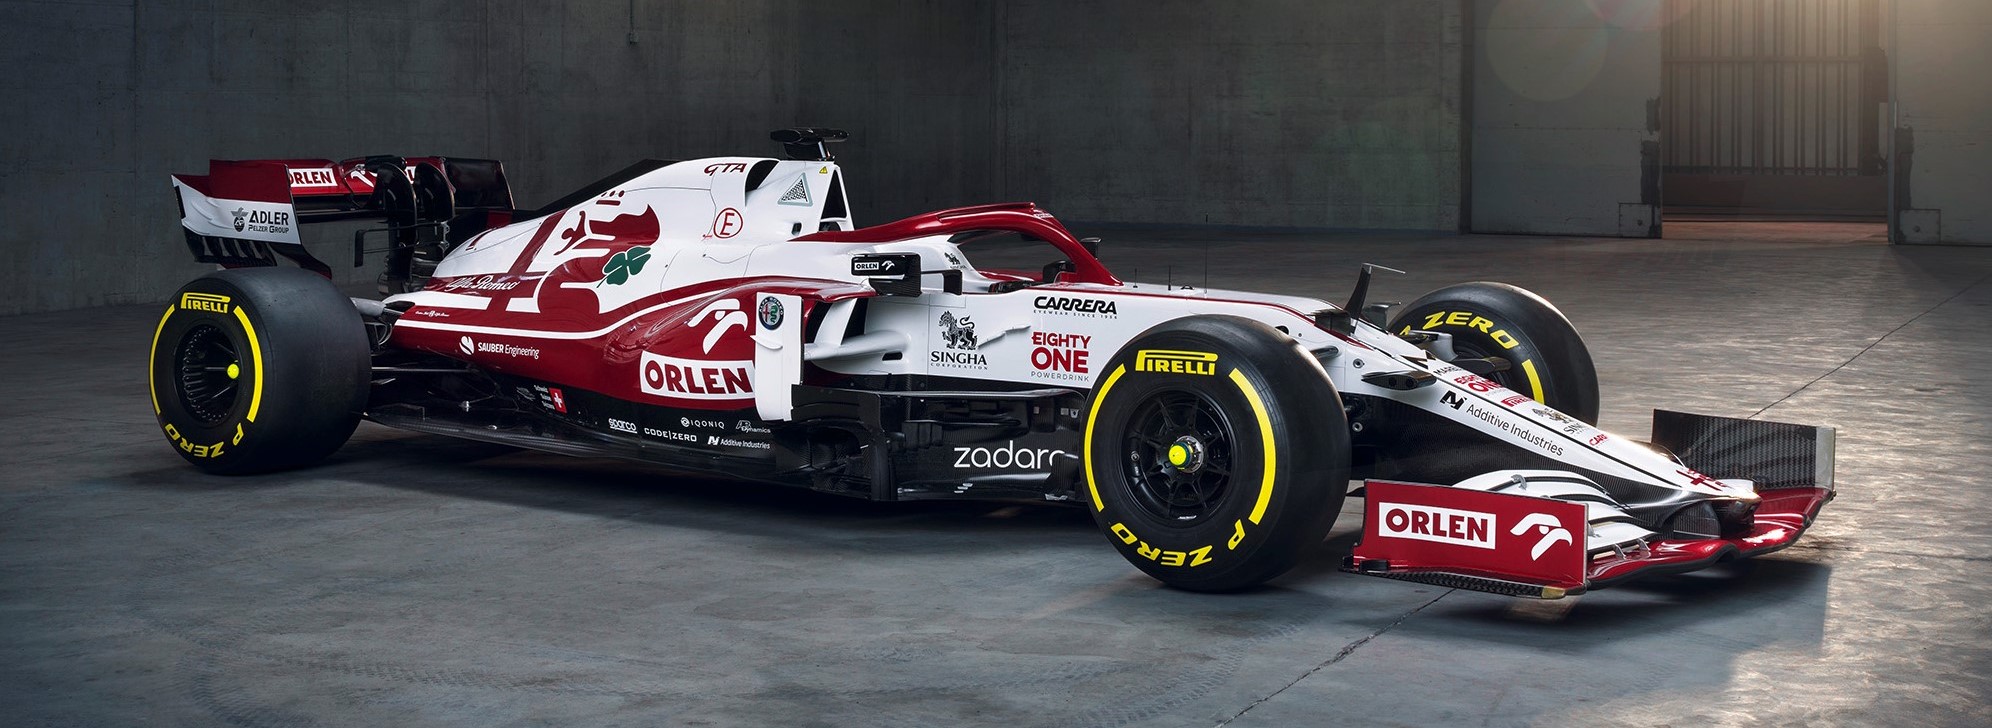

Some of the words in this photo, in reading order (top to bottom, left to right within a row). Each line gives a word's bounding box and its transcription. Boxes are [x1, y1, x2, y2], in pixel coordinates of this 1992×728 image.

[704, 163, 747, 176] GTA
[249, 210, 289, 225] ADLER
[719, 212, 735, 235] E
[269, 225, 289, 234] GROUP
[471, 275, 520, 290] Romeo
[180, 292, 231, 313] PIRELLI
[1034, 296, 1117, 314] CARRERA
[1422, 311, 1520, 349] ZERO
[1031, 332, 1091, 349] EIGHTY
[478, 342, 504, 354] SAUBER
[504, 344, 540, 359] Engineering
[931, 351, 987, 365] SINGHA
[1031, 347, 1089, 373] ONE
[1135, 349, 1219, 375] PIRELLI
[645, 360, 753, 394] ORLEN
[1031, 371, 1089, 381] POWERDRINK
[608, 418, 637, 433] sparco
[690, 419, 724, 429] IQONIQ
[1466, 404, 1510, 431] Additive
[1510, 423, 1564, 456] Industries
[164, 423, 225, 458] ZERO
[232, 422, 244, 446] P
[720, 438, 742, 447] Additive
[742, 440, 770, 449] Industries
[1228, 519, 1246, 550] P
[1385, 508, 1487, 542] ORLEN
[1110, 522, 1213, 567] ZERO
